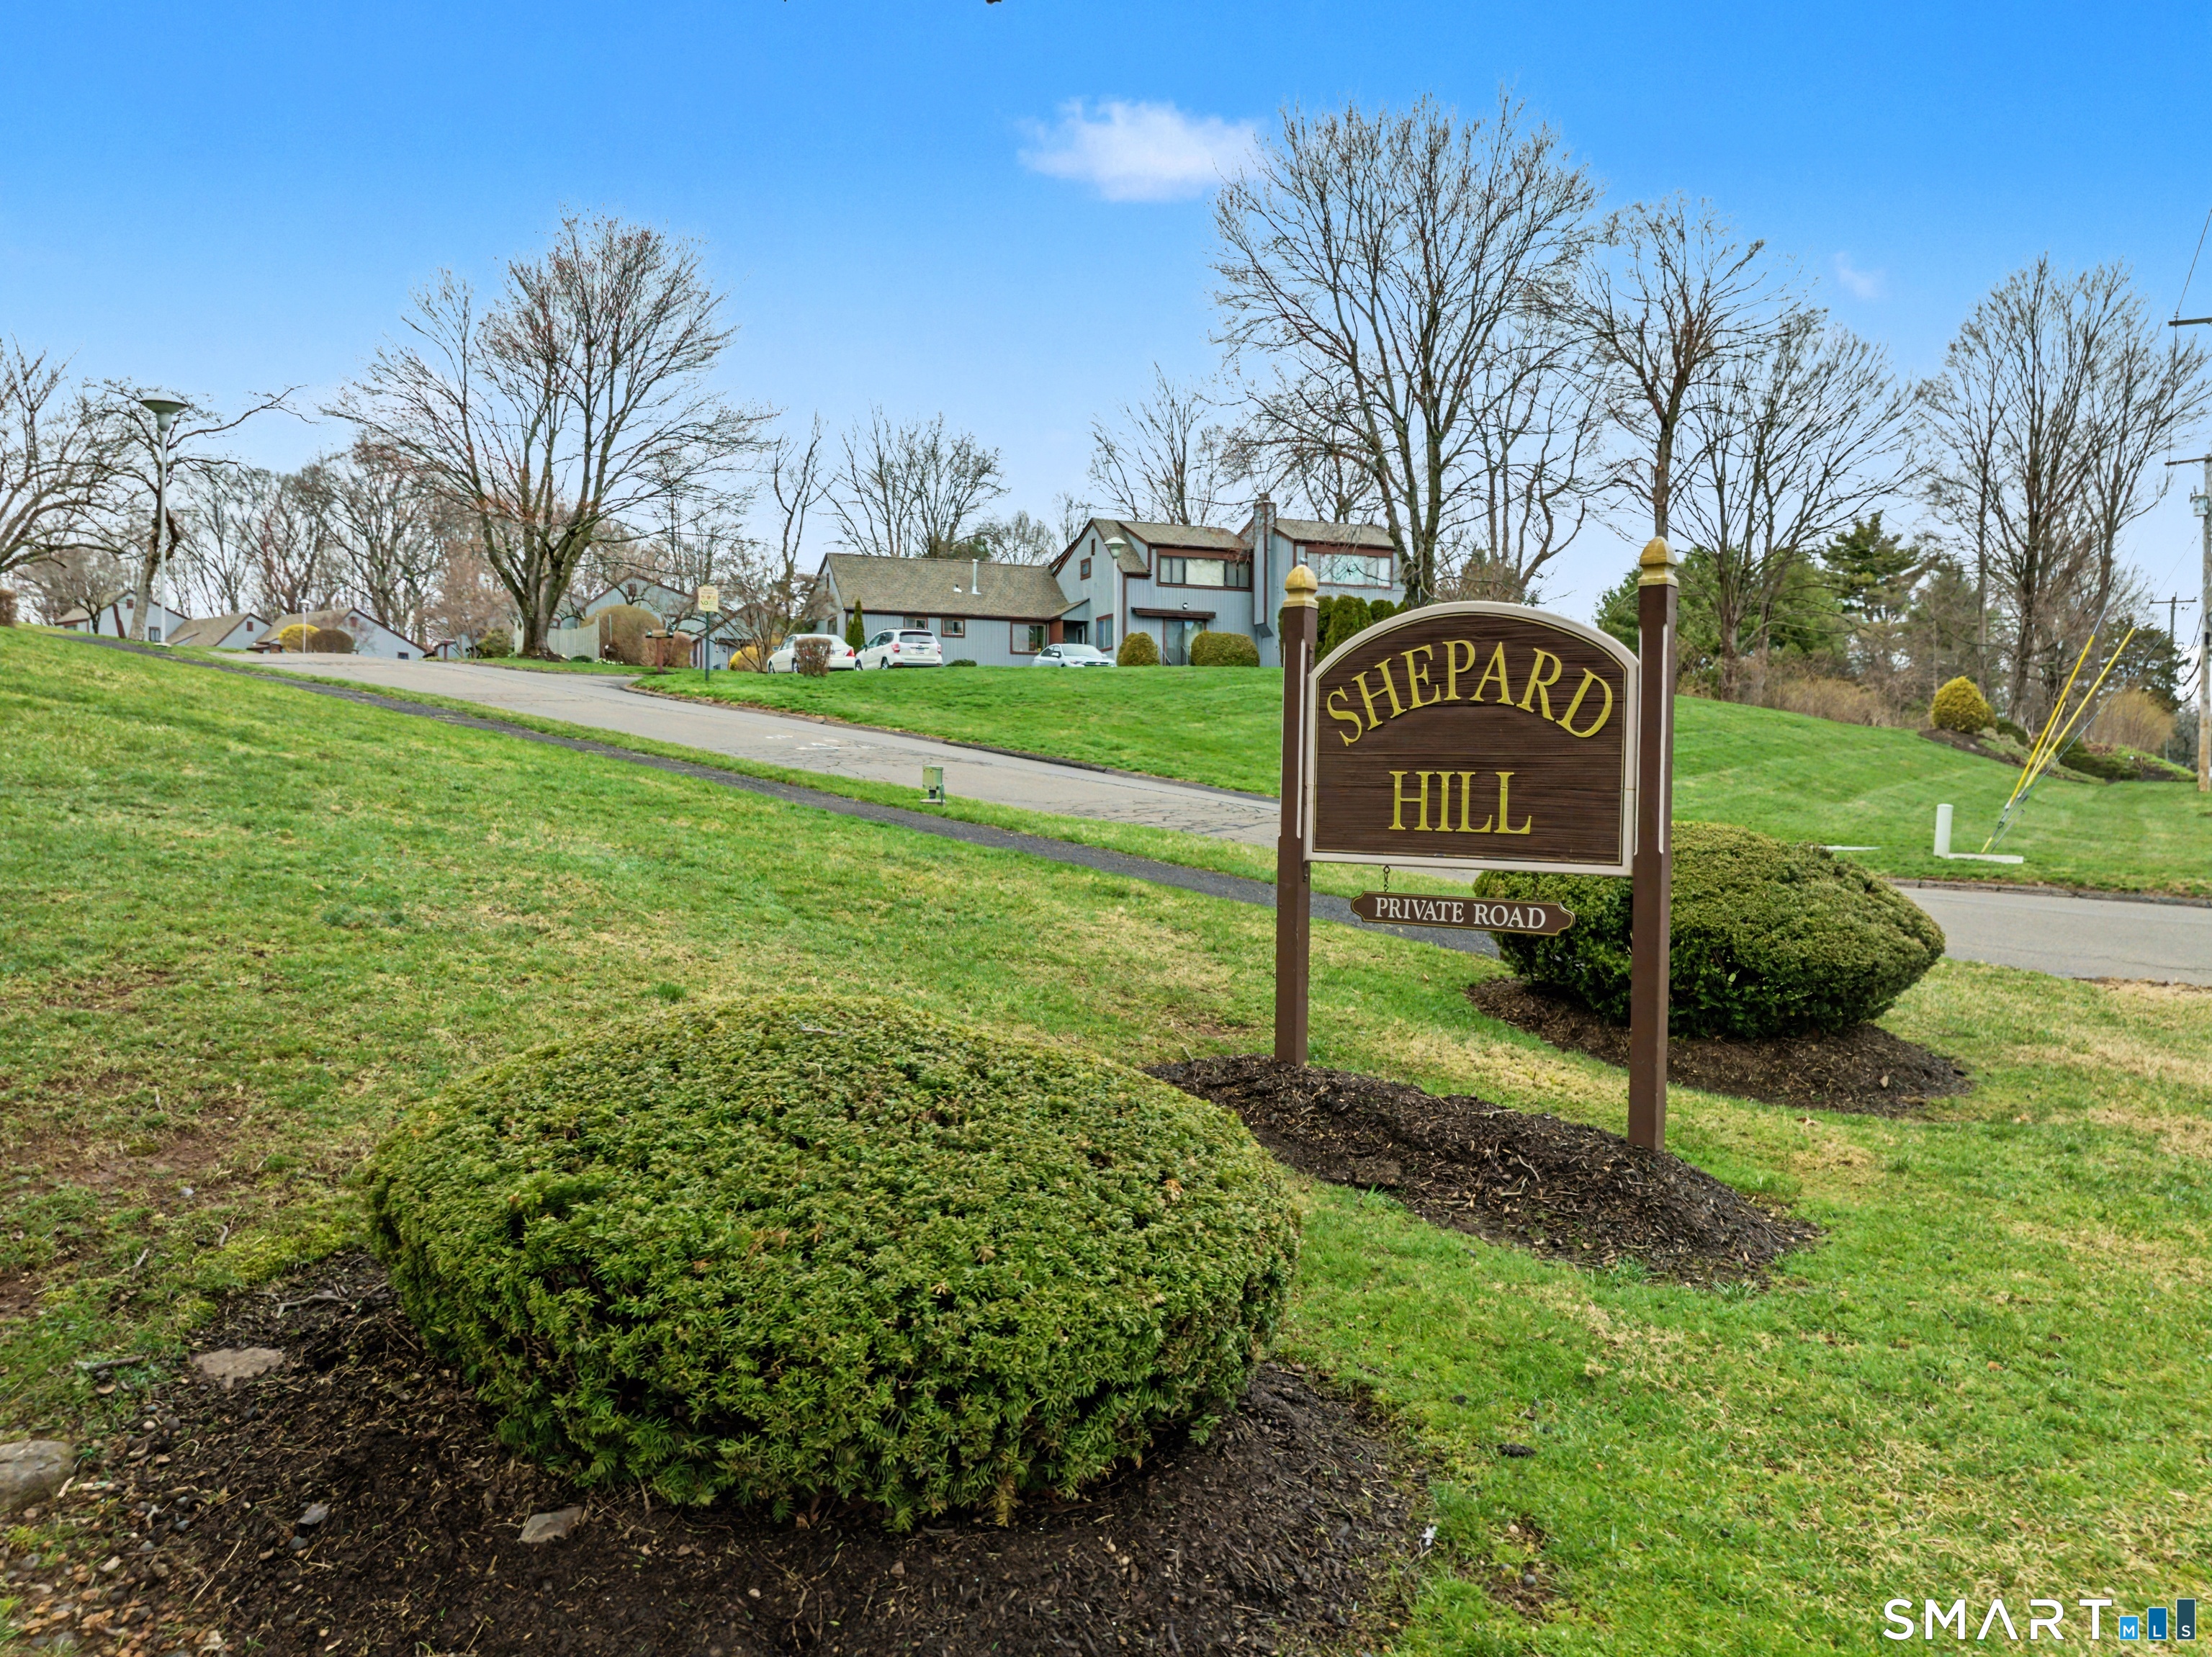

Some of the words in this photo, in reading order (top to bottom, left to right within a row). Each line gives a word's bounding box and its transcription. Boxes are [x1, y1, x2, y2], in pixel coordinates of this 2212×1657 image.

[1326, 639, 1614, 747] SHEPARD
[1388, 771, 1532, 835] HILL
[1375, 897, 1465, 923] PRIVATE
[1473, 902, 1547, 929] ROAD
